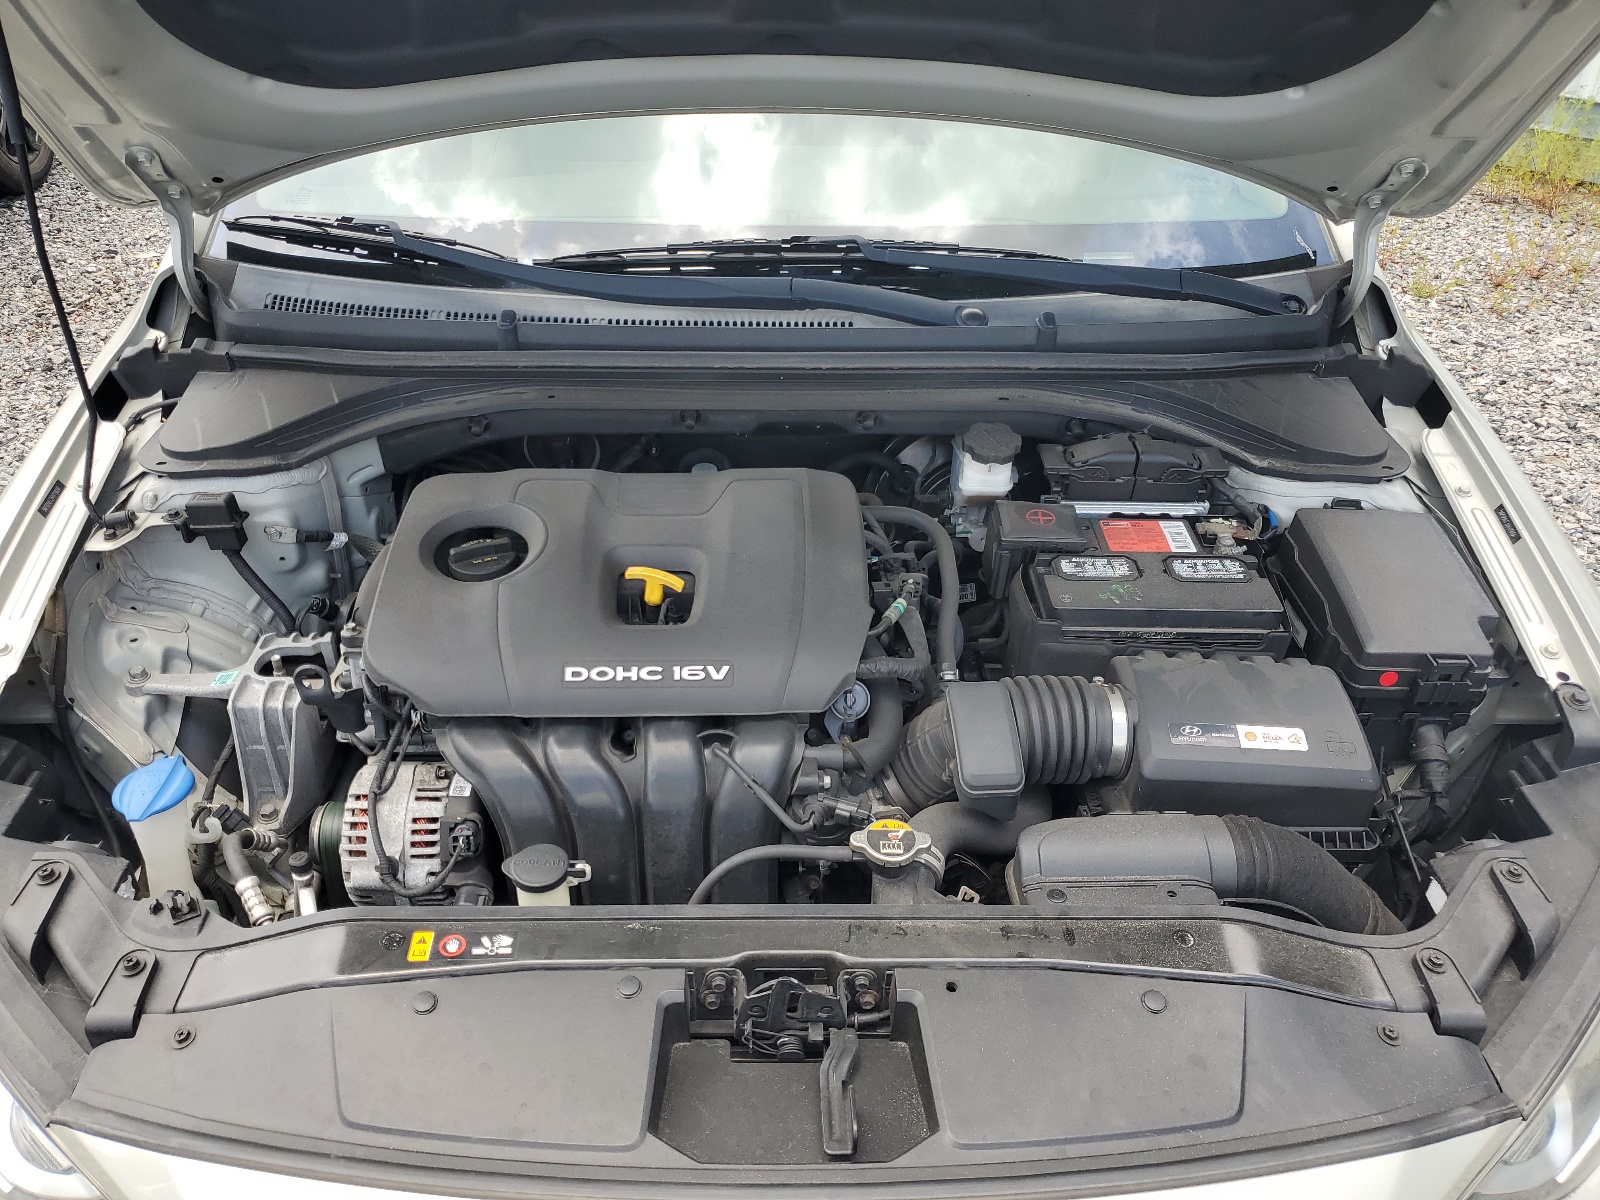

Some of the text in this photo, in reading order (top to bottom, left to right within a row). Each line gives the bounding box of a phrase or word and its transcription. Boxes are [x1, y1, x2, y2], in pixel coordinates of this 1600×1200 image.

[564, 665, 731, 682] DOHC 16V
[513, 858, 568, 868] COOLANT
